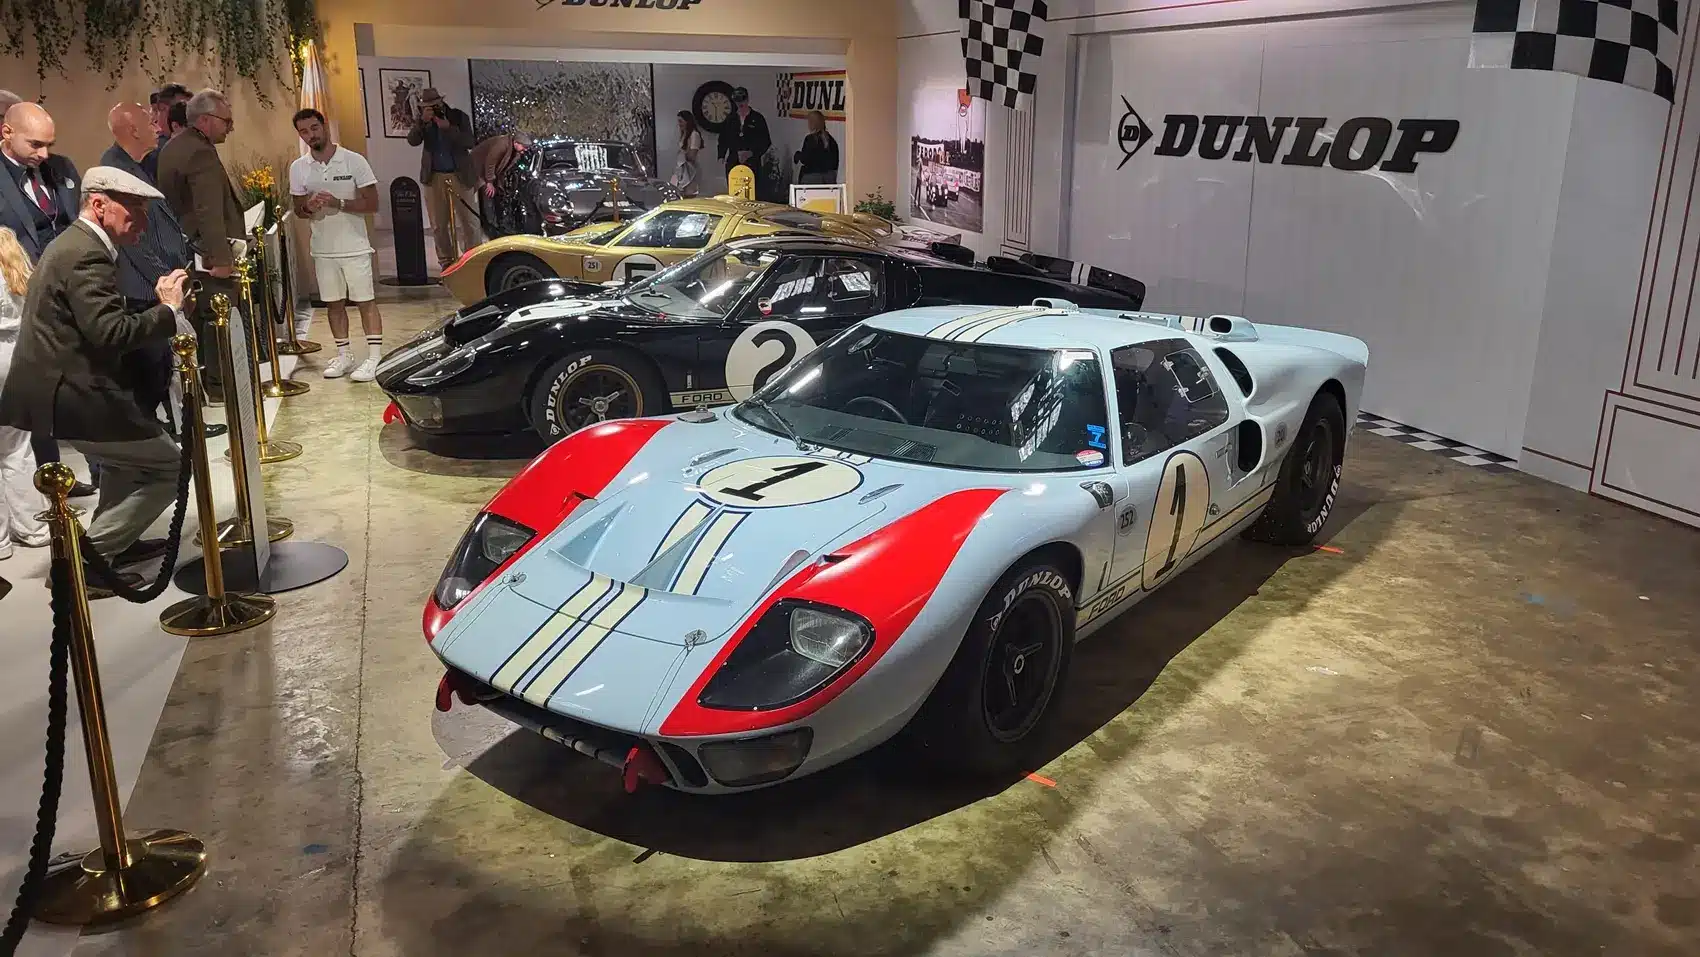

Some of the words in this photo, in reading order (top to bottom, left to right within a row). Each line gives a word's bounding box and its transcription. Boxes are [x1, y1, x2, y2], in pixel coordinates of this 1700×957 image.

[1154, 114, 1460, 173] DUNLOP
[587, 261, 599, 269] 251
[751, 328, 797, 395] 2
[545, 354, 593, 423] DUNLOP
[681, 392, 723, 404] FORD
[718, 461, 829, 502] 1
[1120, 509, 1134, 529] 252
[1153, 462, 1187, 581] 1
[1307, 478, 1339, 534] DUNLOP
[1003, 570, 1072, 614] DUNLOP
[1087, 585, 1126, 620] FORD
